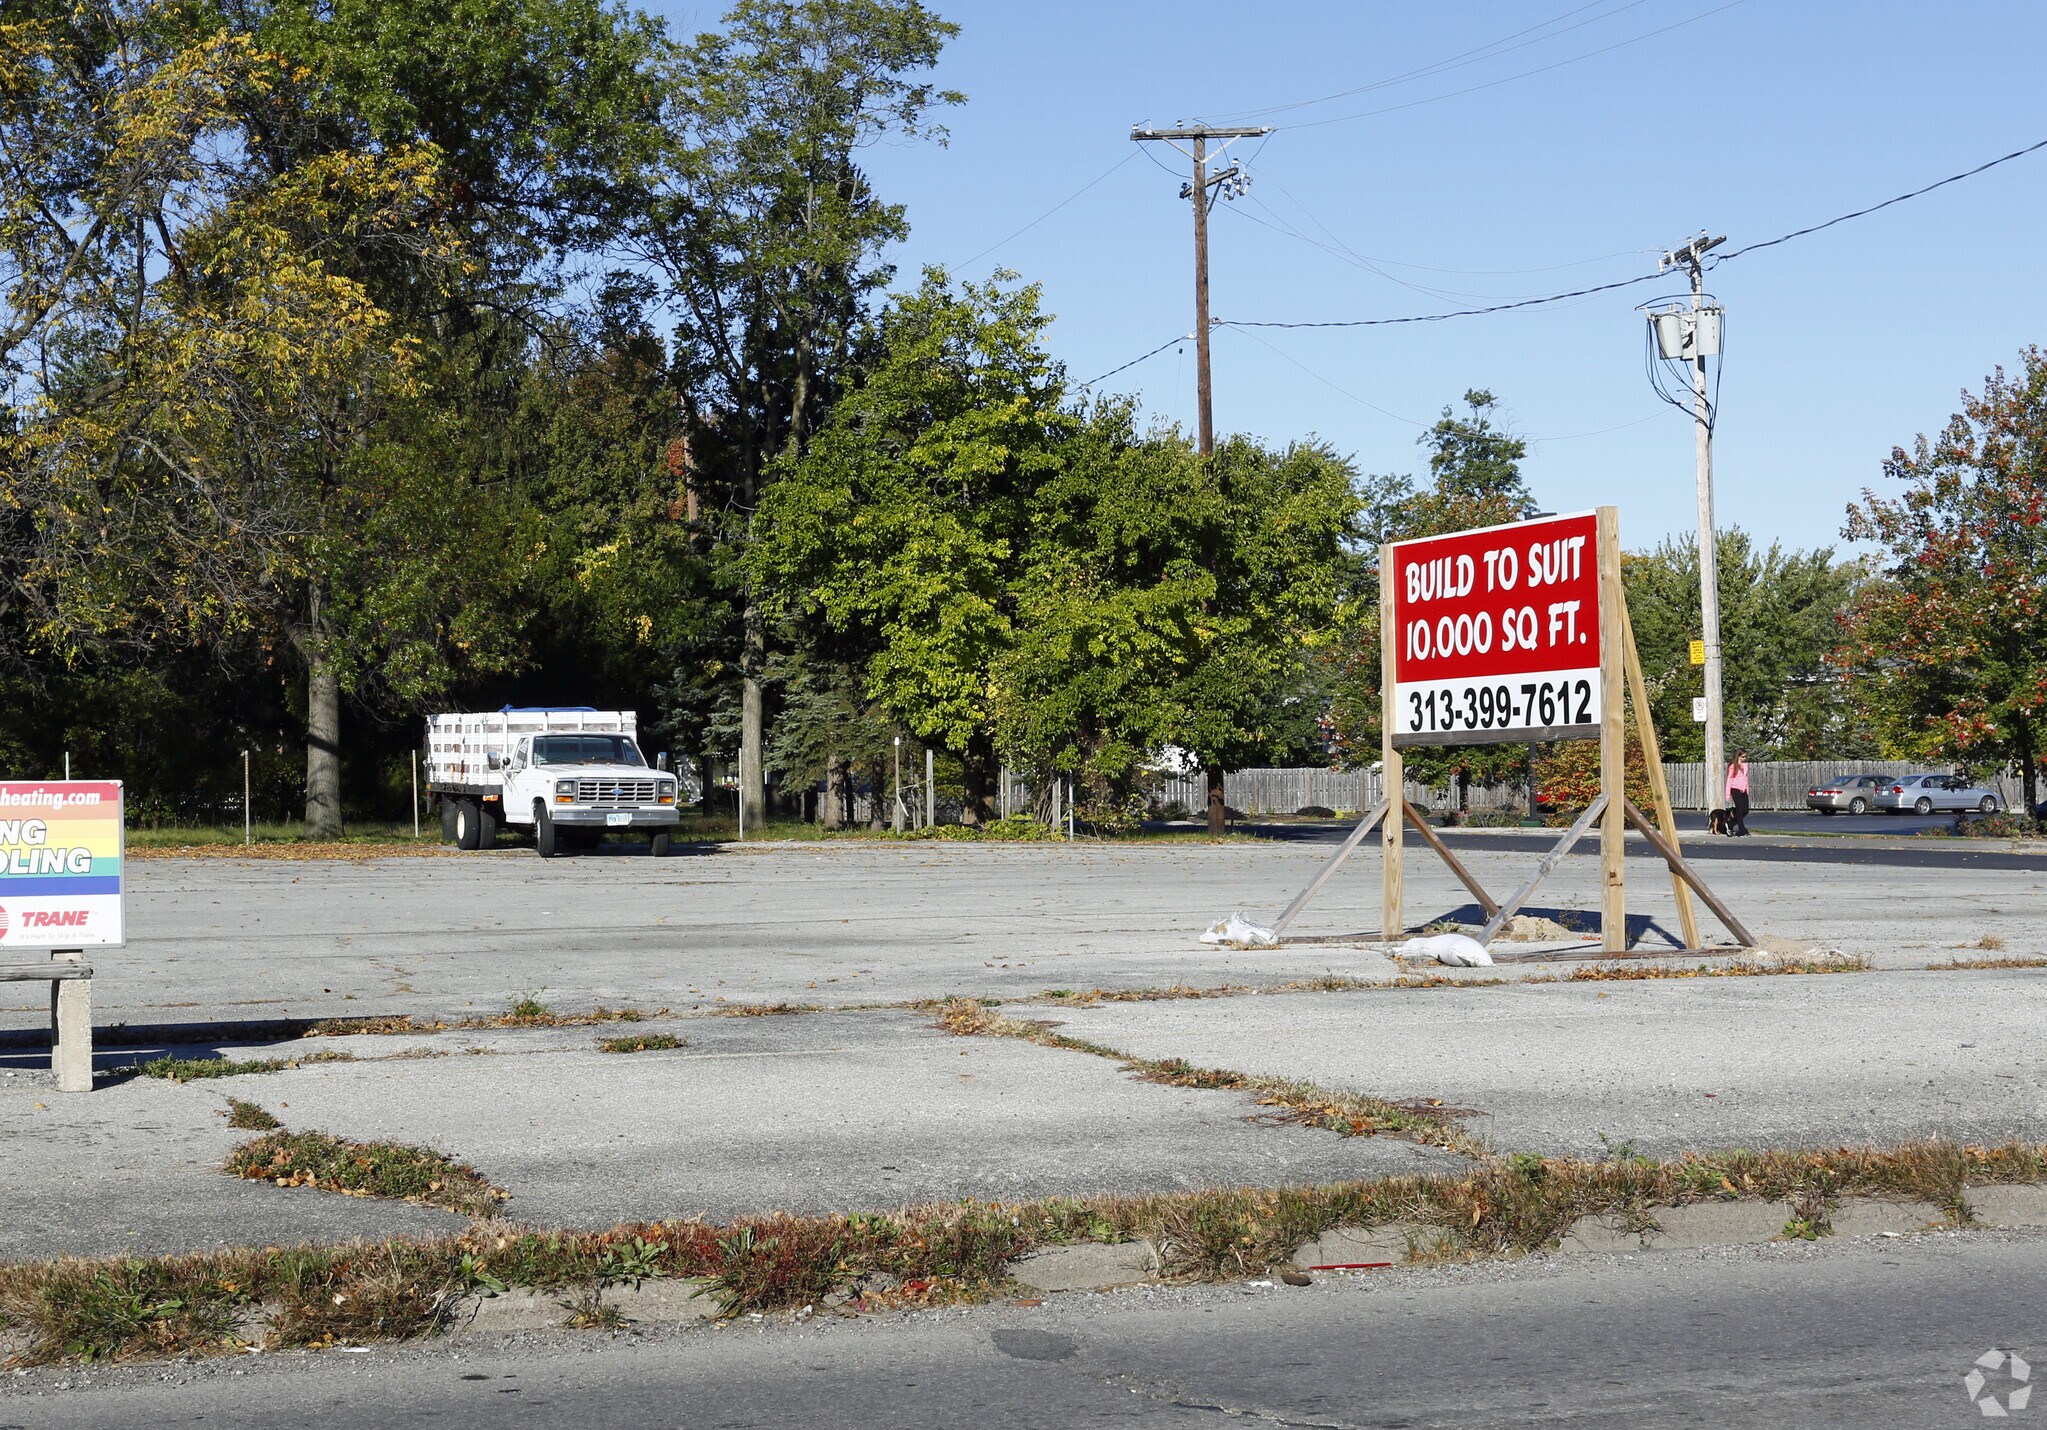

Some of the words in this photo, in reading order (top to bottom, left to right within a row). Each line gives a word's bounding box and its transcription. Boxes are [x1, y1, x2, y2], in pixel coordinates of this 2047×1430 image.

[1405, 553, 1475, 604] BUILD
[1483, 546, 1519, 593] TO
[1528, 535, 1586, 588] SUIT
[1406, 611, 1493, 662] 10,000
[1502, 605, 1538, 652] SQ
[1548, 600, 1587, 648] FT.
[1409, 679, 1592, 732] 313-399-7612
[21, 910, 90, 927] TRANE
